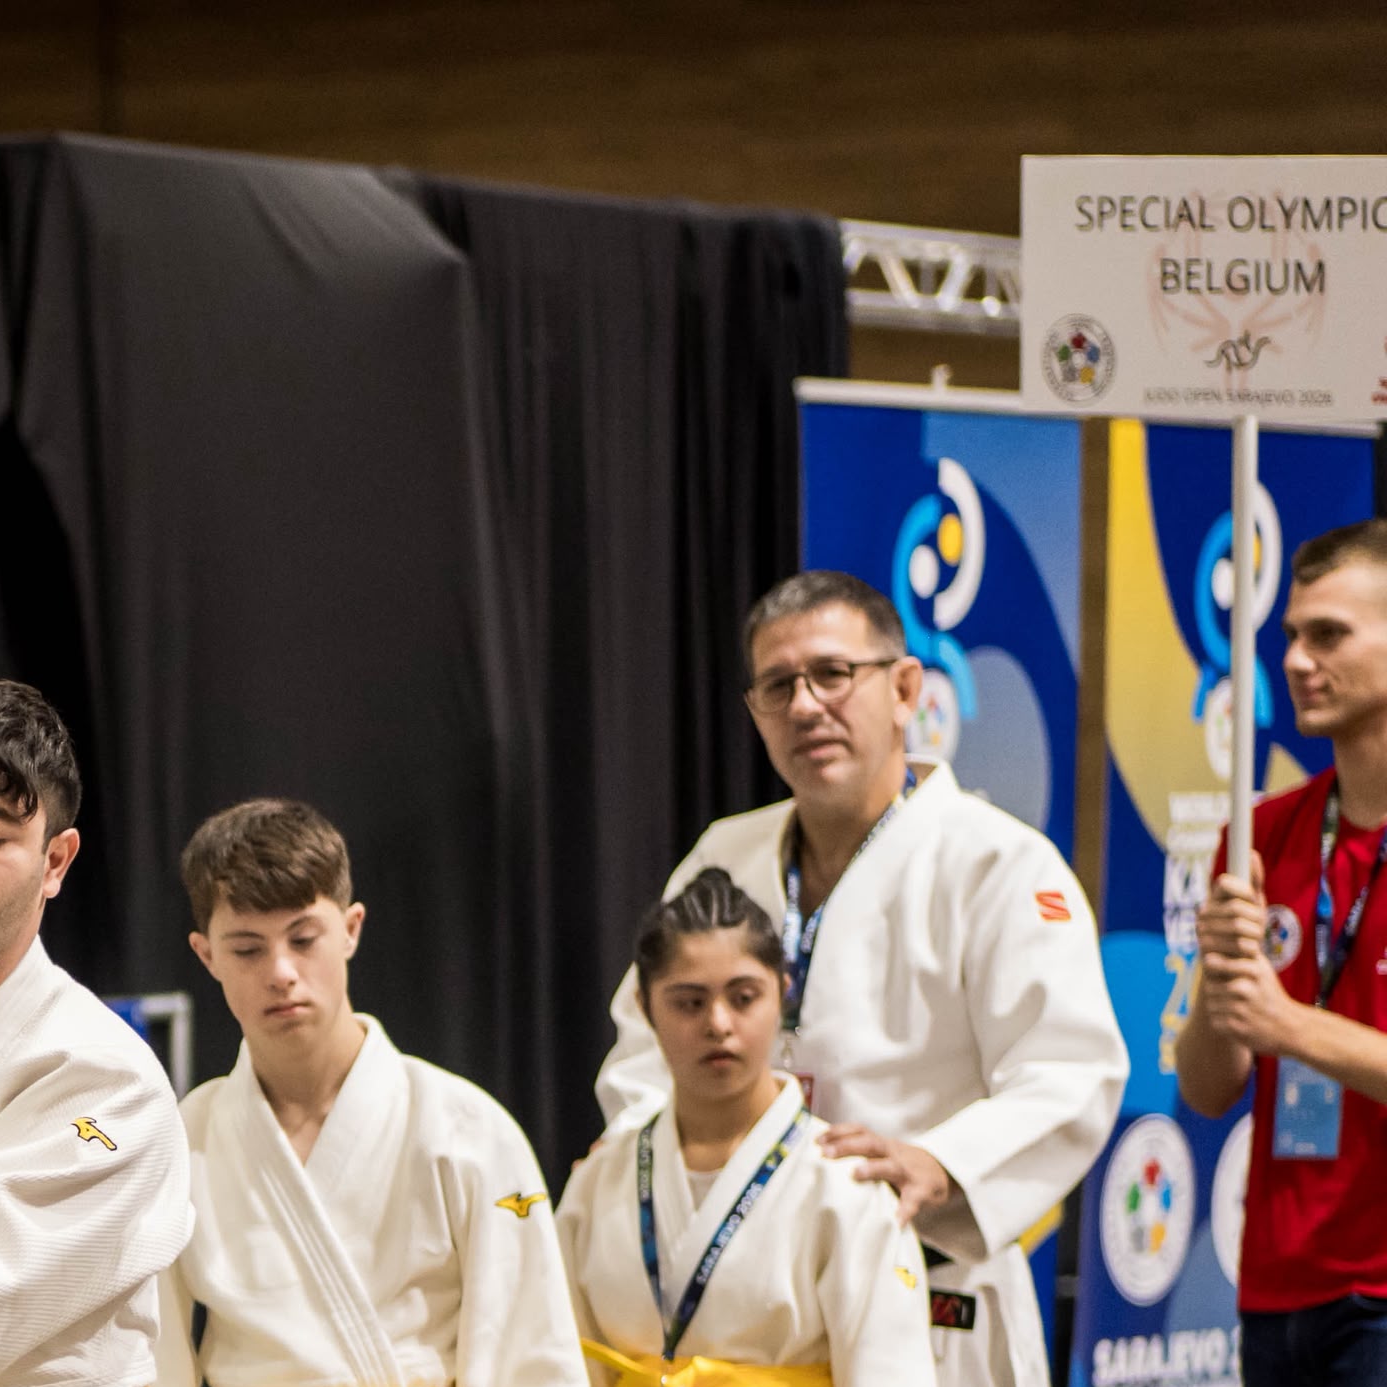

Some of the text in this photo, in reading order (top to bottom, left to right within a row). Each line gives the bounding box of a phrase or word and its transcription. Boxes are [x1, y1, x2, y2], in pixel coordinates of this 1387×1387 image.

[1074, 195, 1387, 233] SPECIAL OLYMPIC
[1159, 257, 1326, 295] BELGIUM
[696, 1213, 741, 1285] SARAJEVO
